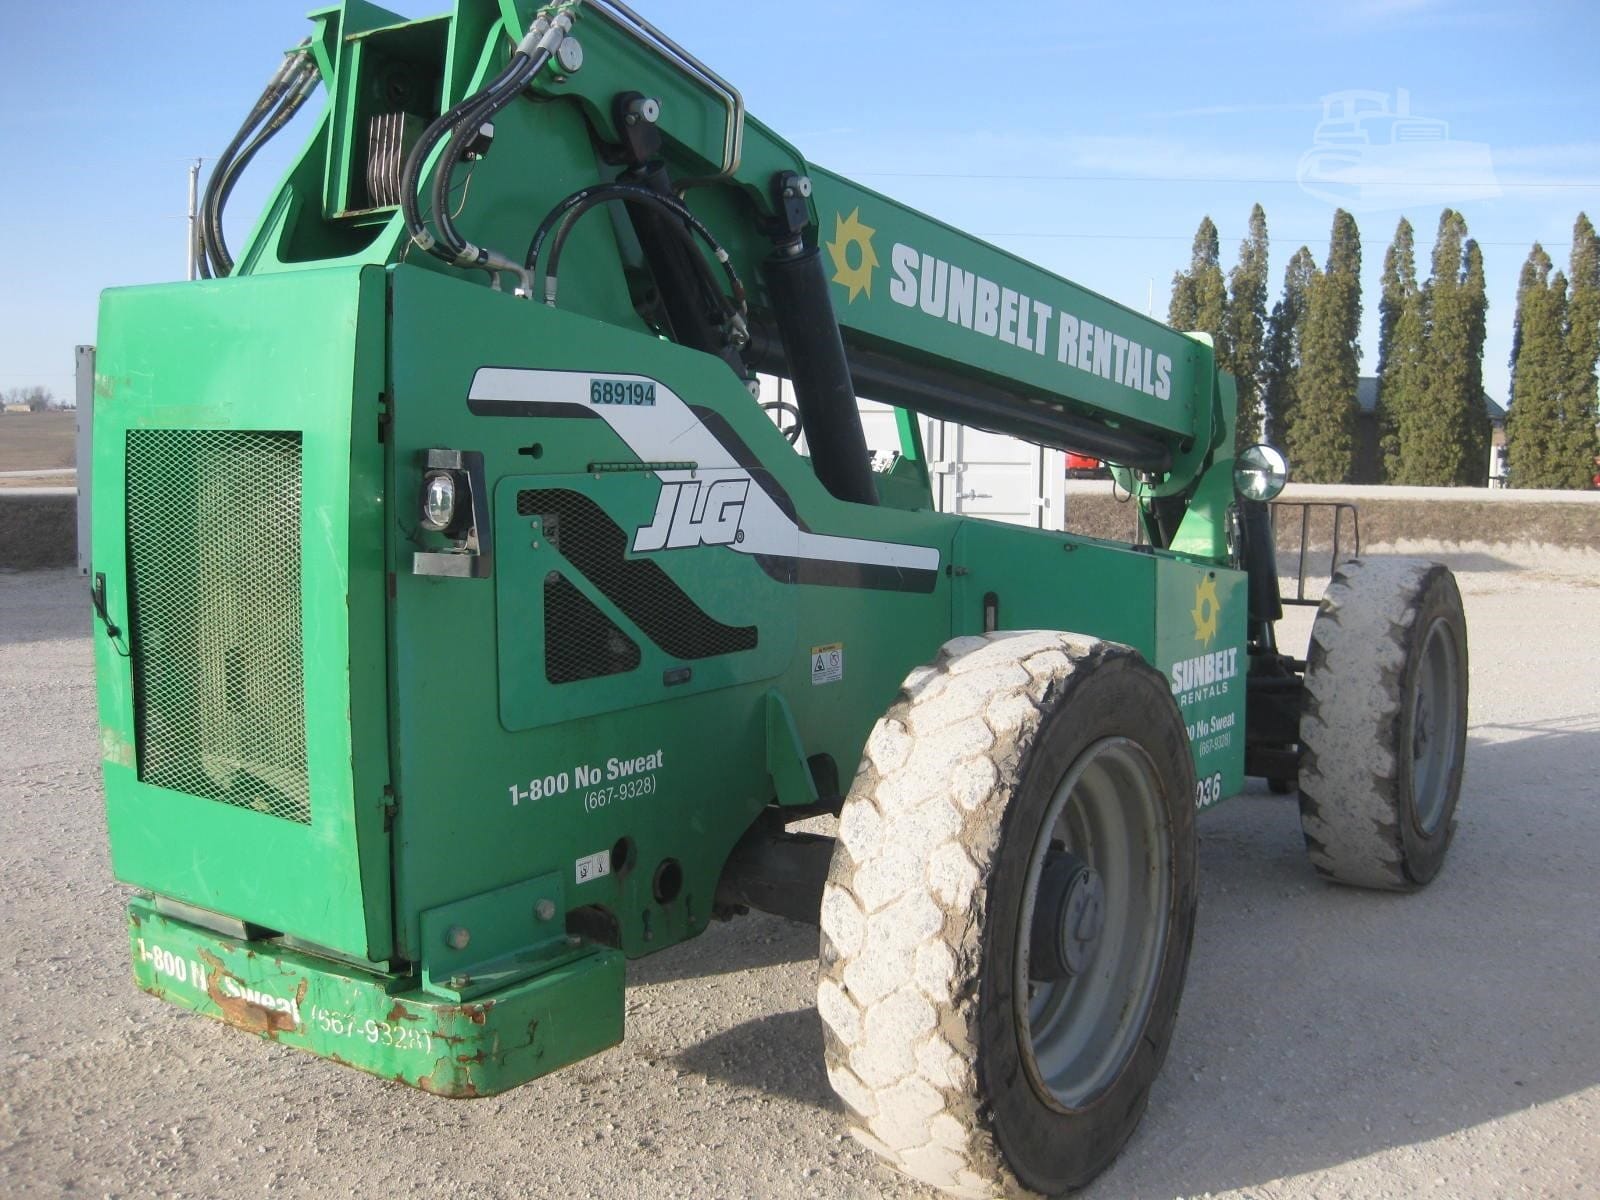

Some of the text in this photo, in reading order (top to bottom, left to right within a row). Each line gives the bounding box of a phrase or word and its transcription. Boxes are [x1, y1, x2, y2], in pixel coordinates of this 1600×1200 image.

[889, 242, 1172, 401] SUNBELT RENTALS
[591, 381, 656, 406] 689194
[632, 479, 750, 552] JLG
[1171, 647, 1237, 695] SUNBELT
[1180, 681, 1229, 707] RENTALS
[1196, 719, 1209, 739] No
[1210, 712, 1235, 733] Sweat
[508, 748, 663, 806] 1-800 No Sweat
[584, 774, 656, 813] (667-9328)
[1195, 772, 1221, 809] 036
[137, 937, 187, 983] 1-800
